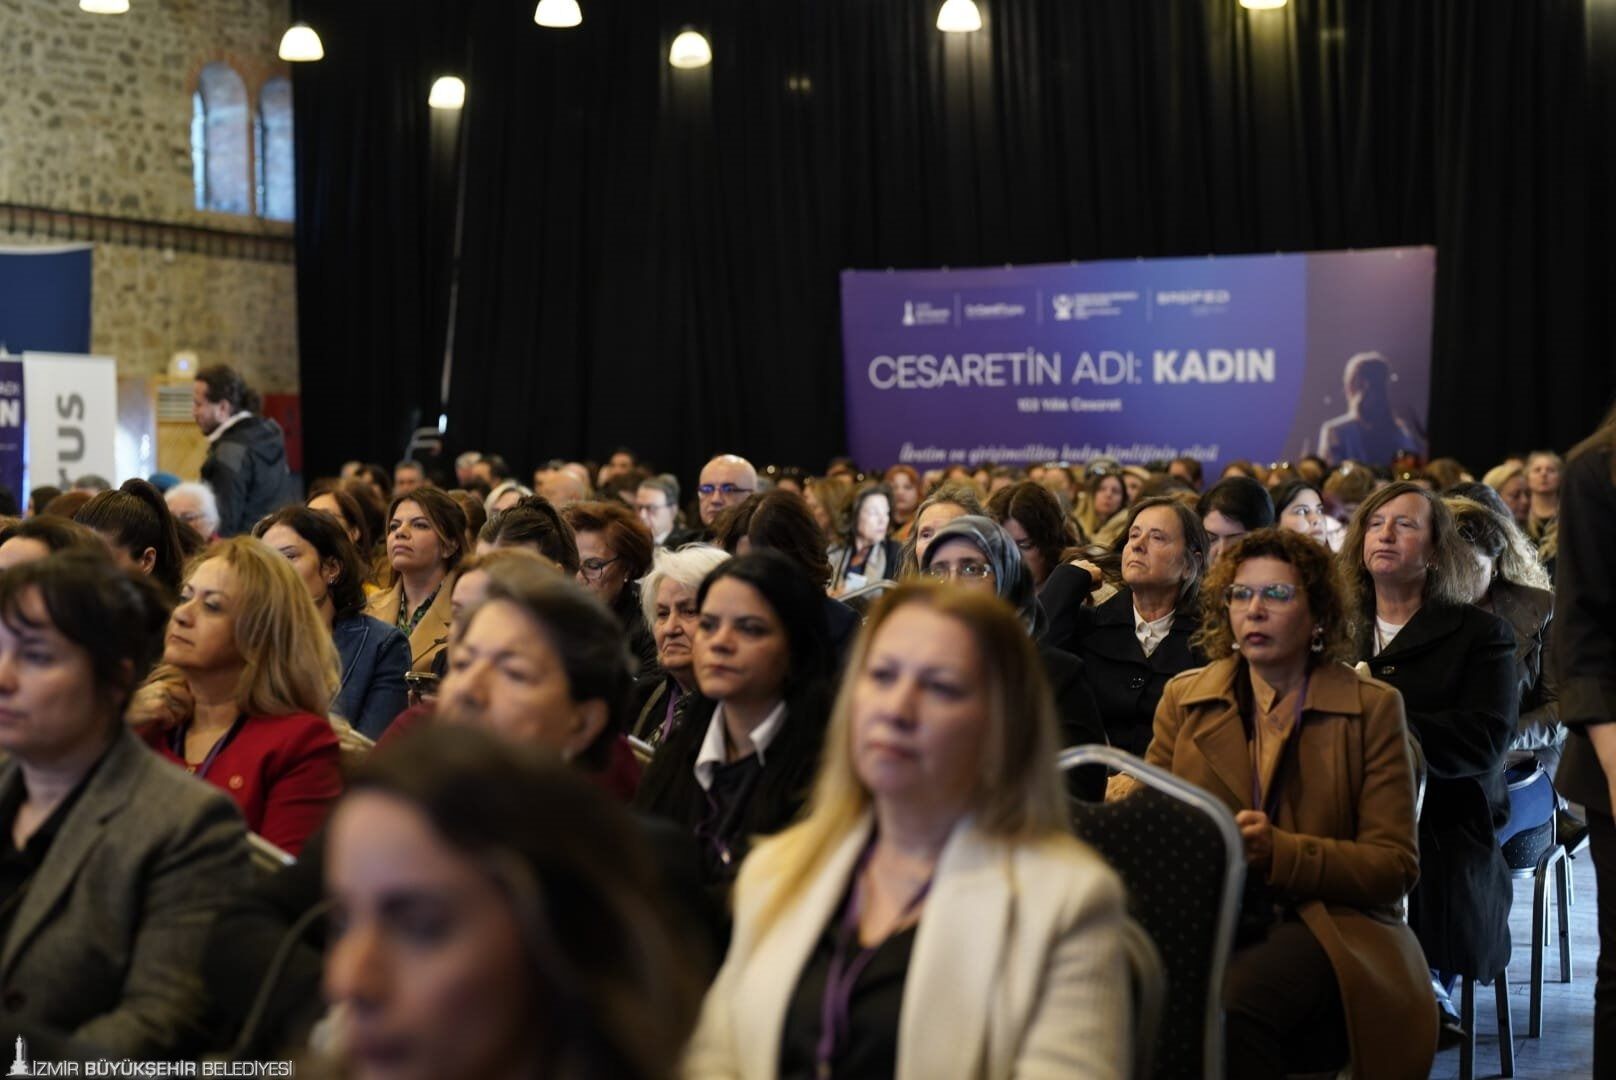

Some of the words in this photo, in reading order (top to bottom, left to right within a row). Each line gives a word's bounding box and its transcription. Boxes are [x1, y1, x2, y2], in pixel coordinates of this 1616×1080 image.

[868, 346, 1062, 389] CESARETİN
[1071, 351, 1142, 385] ADI:
[1153, 348, 1276, 383] KADIN
